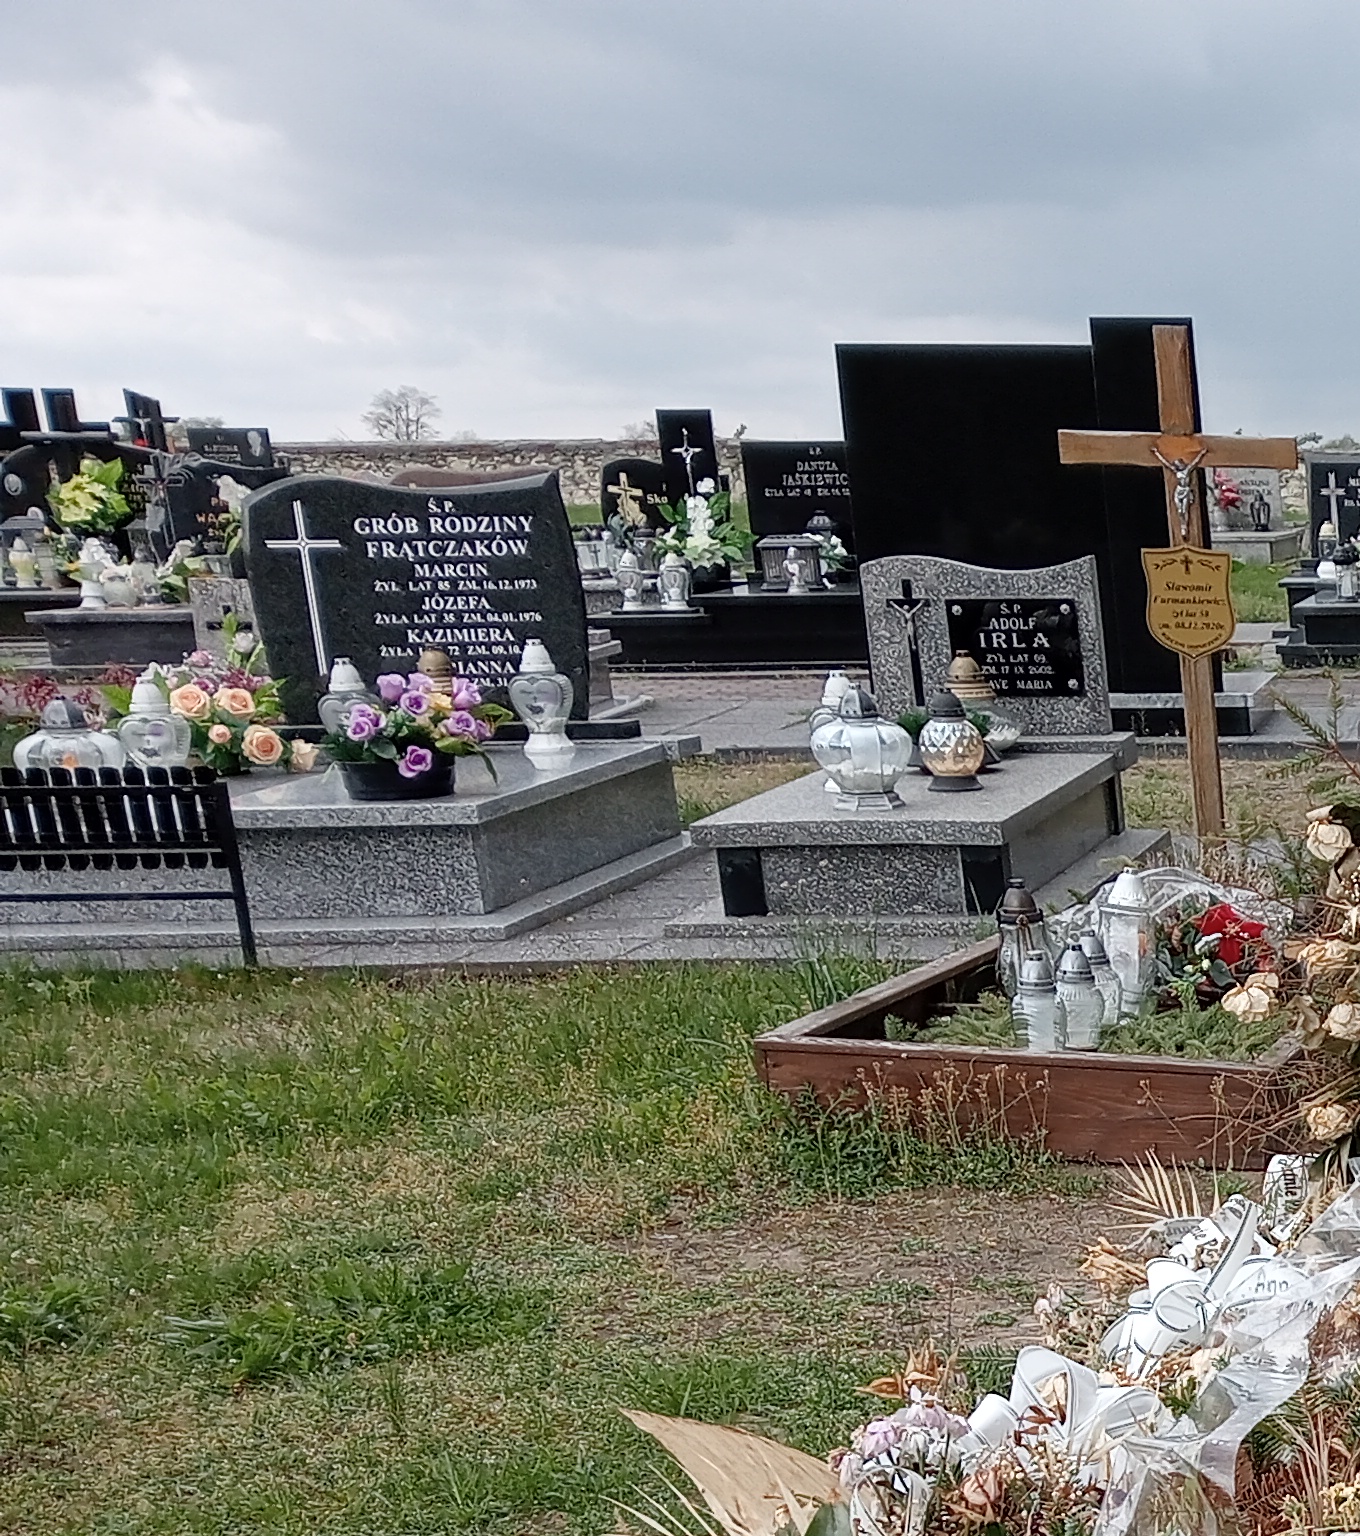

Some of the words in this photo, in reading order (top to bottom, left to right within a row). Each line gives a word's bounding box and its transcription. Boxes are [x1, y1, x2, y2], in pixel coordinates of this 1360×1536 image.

[353, 513, 419, 535] GRÓB
[429, 515, 533, 534] RODZINY
[366, 535, 529, 561] FRĄTCZAKÓW
[414, 563, 489, 577] MARCIN
[409, 581, 432, 591] LAT
[422, 592, 492, 610] JÓZEFA
[414, 614, 436, 624] LAT
[989, 617, 1036, 630] ADOLF
[406, 628, 515, 643] KAZIMIERA
[979, 632, 1050, 648] IRLA
[1009, 654, 1029, 663] LAT
[1016, 680, 1053, 689] MARIA
